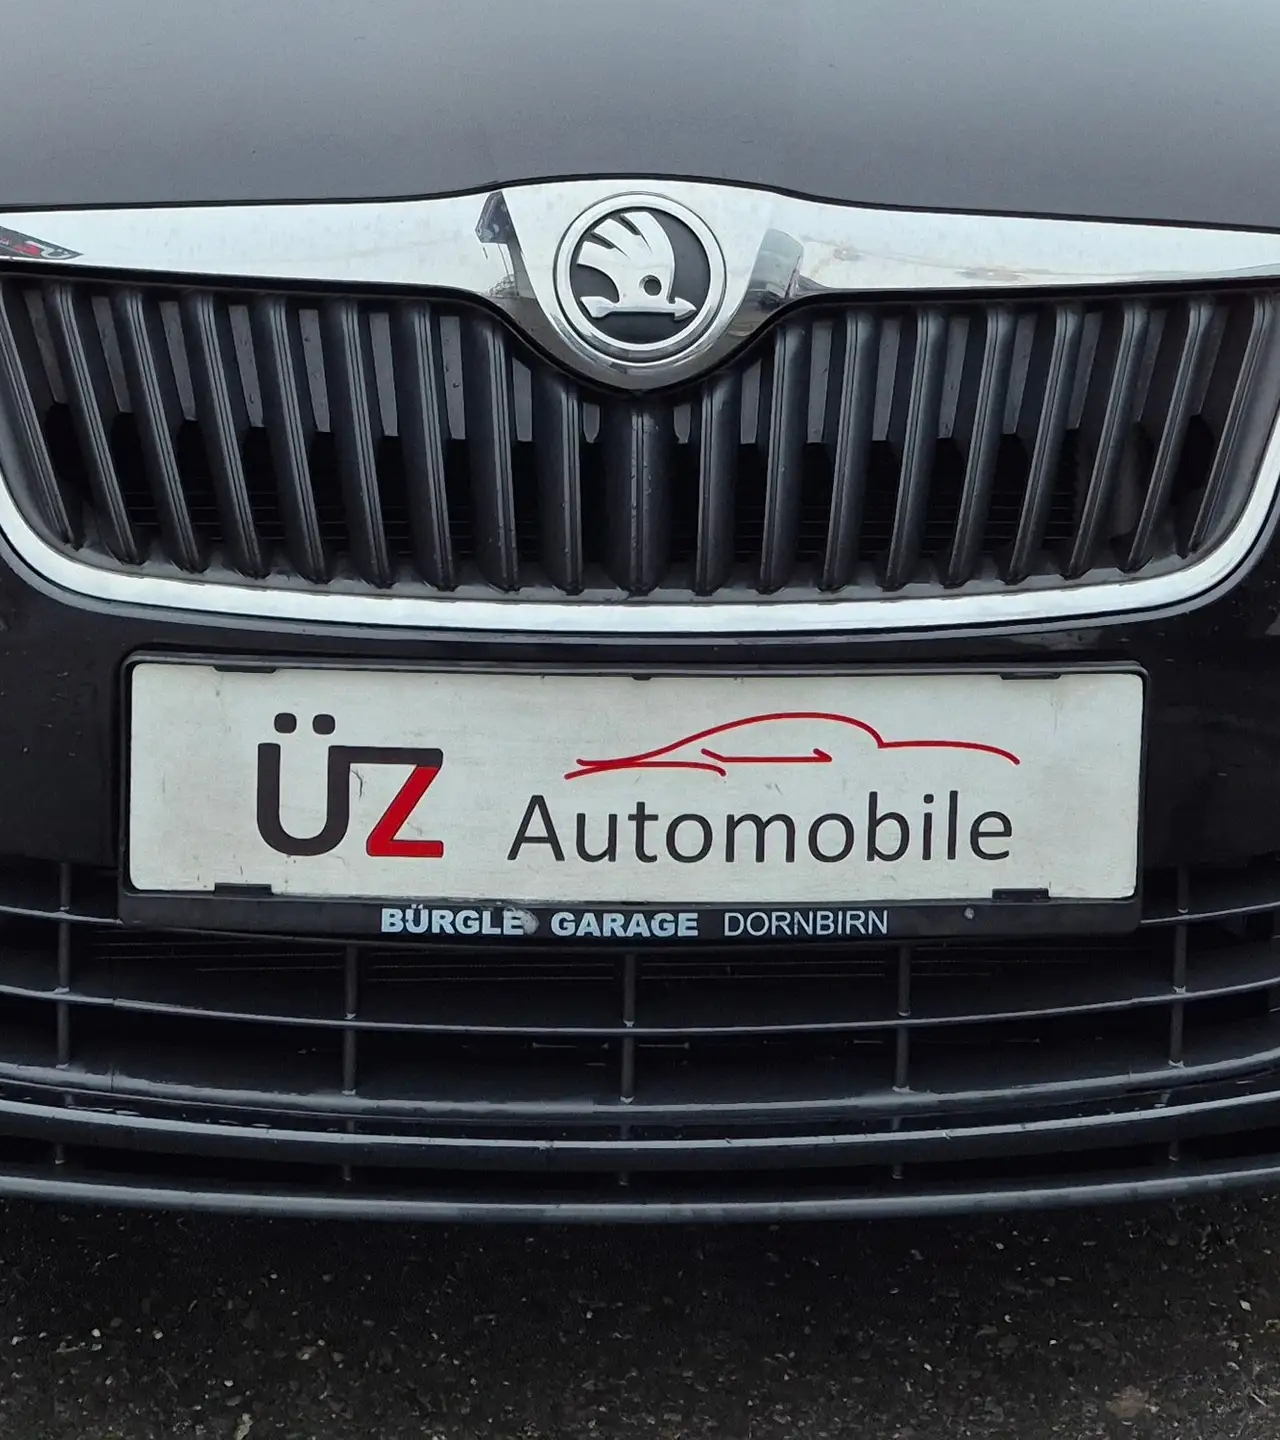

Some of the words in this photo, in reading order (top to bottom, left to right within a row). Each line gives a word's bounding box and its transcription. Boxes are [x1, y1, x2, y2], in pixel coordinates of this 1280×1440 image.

[255, 712, 445, 858] ÜZ
[507, 789, 1015, 865] Automobile
[380, 903, 525, 936] BÜRGLE
[550, 911, 699, 938] GARAGE
[723, 910, 889, 936] DORNBIRN
